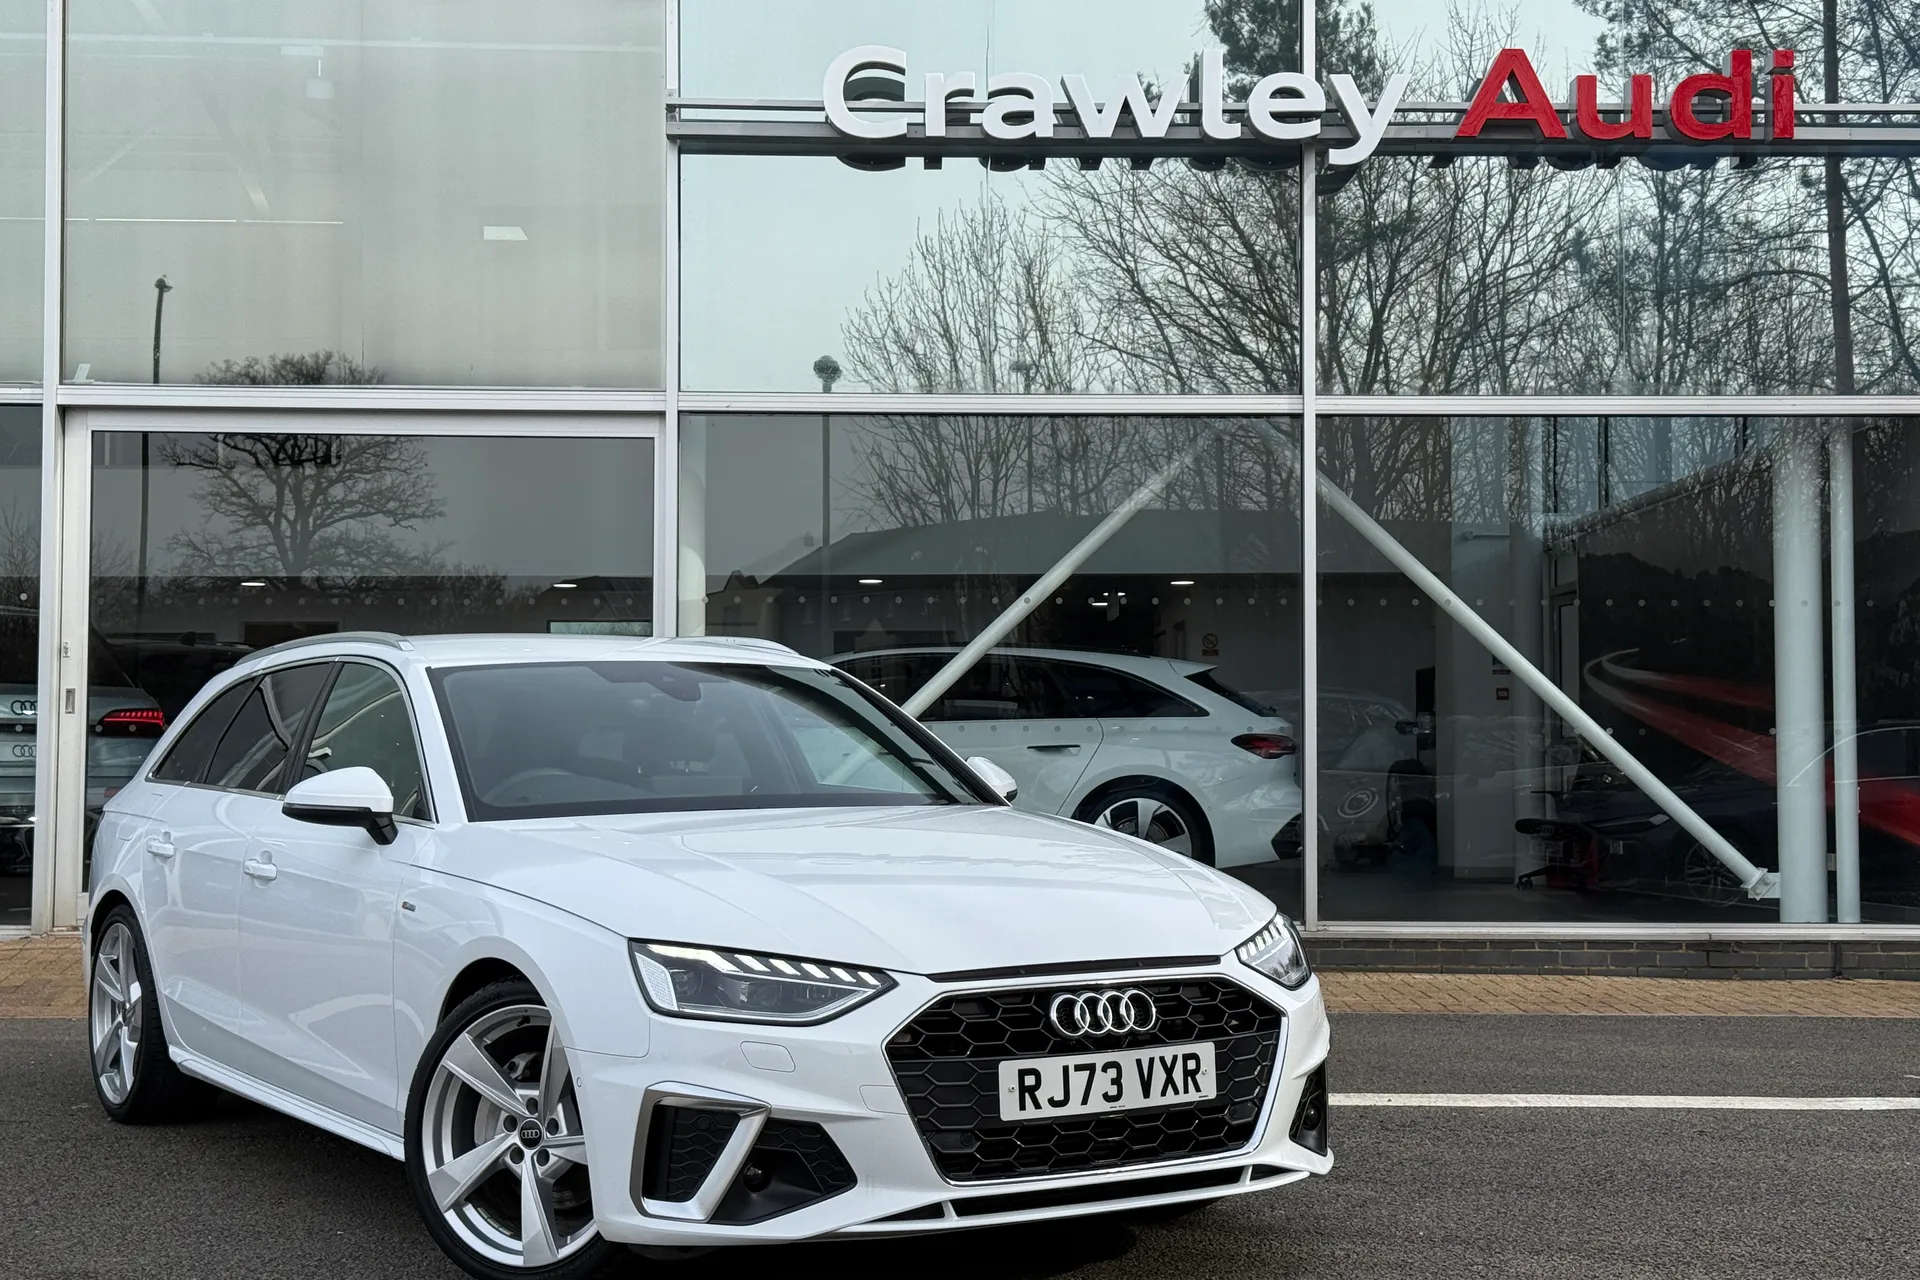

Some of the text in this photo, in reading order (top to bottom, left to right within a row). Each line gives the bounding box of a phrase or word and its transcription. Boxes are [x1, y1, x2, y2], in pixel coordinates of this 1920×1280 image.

[822, 45, 1795, 166] Crawley Audi
[1017, 1052, 1202, 1111] RJ73 VXR
